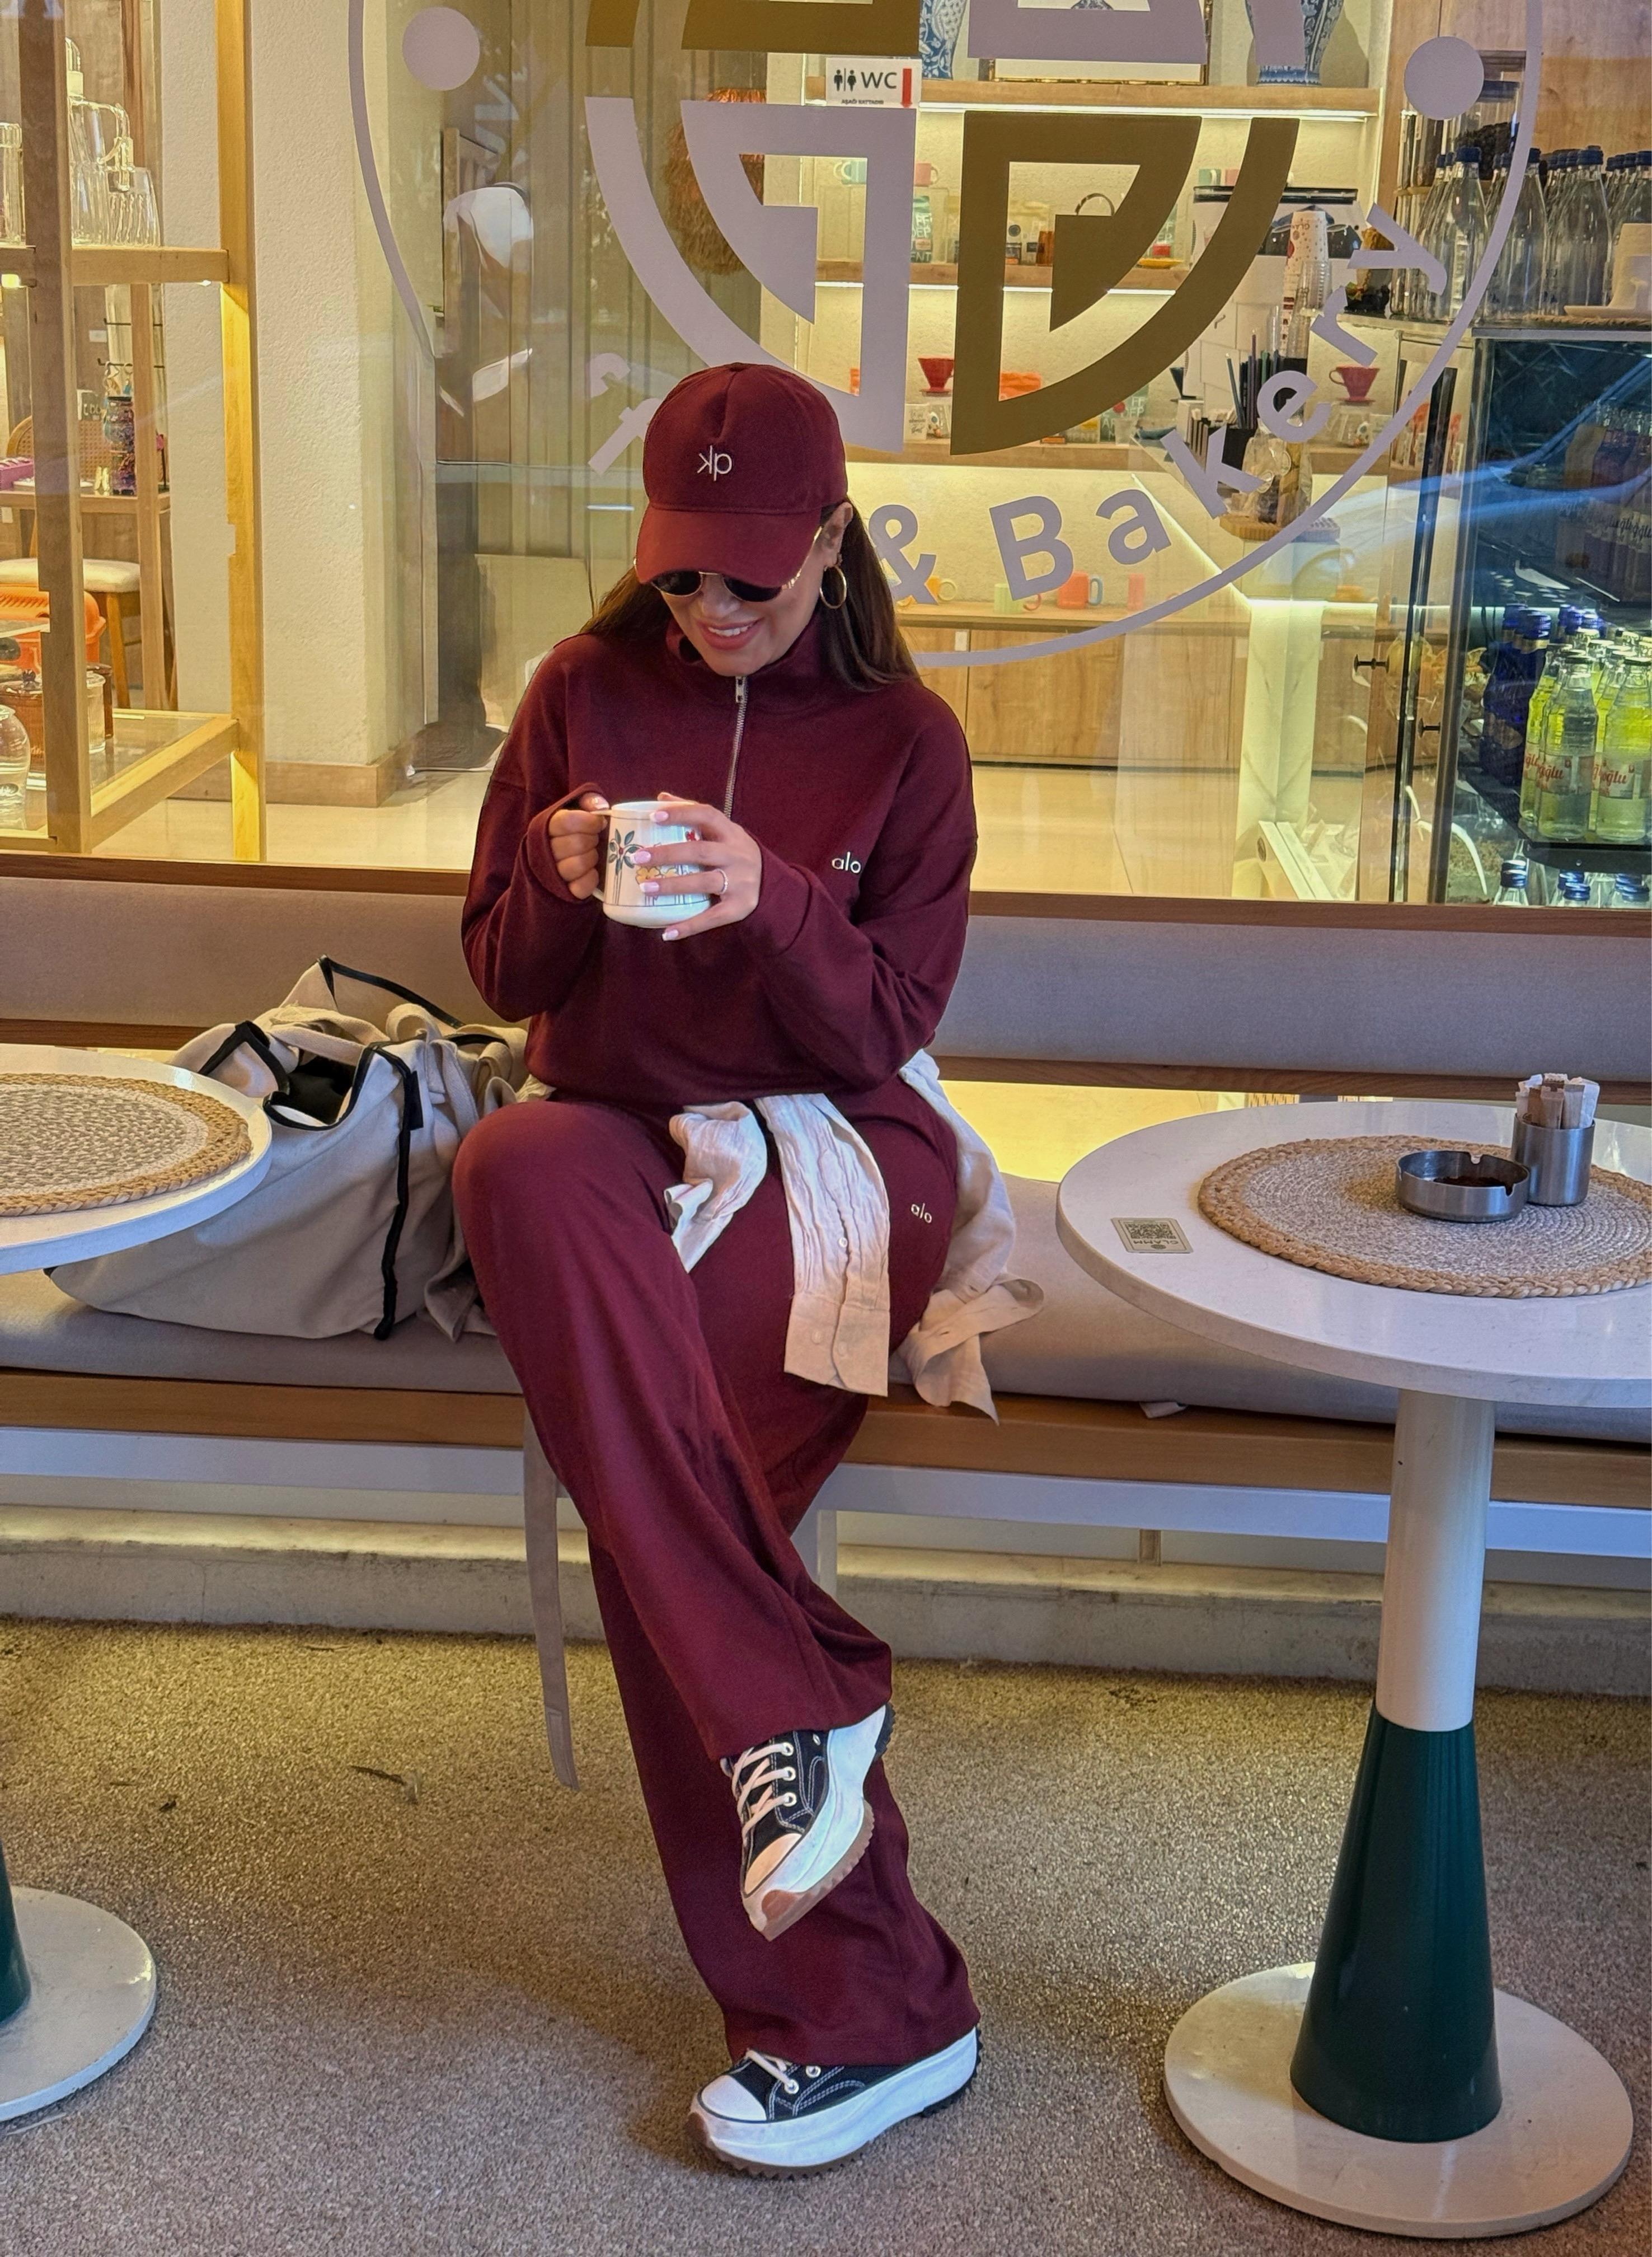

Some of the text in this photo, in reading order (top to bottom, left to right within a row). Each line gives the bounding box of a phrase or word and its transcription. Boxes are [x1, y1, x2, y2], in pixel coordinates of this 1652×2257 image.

[861, 72, 897, 89] WC
[869, 203, 1448, 605] & Bakery
[832, 851, 861, 873] alo
[911, 1202, 932, 1224] alo
